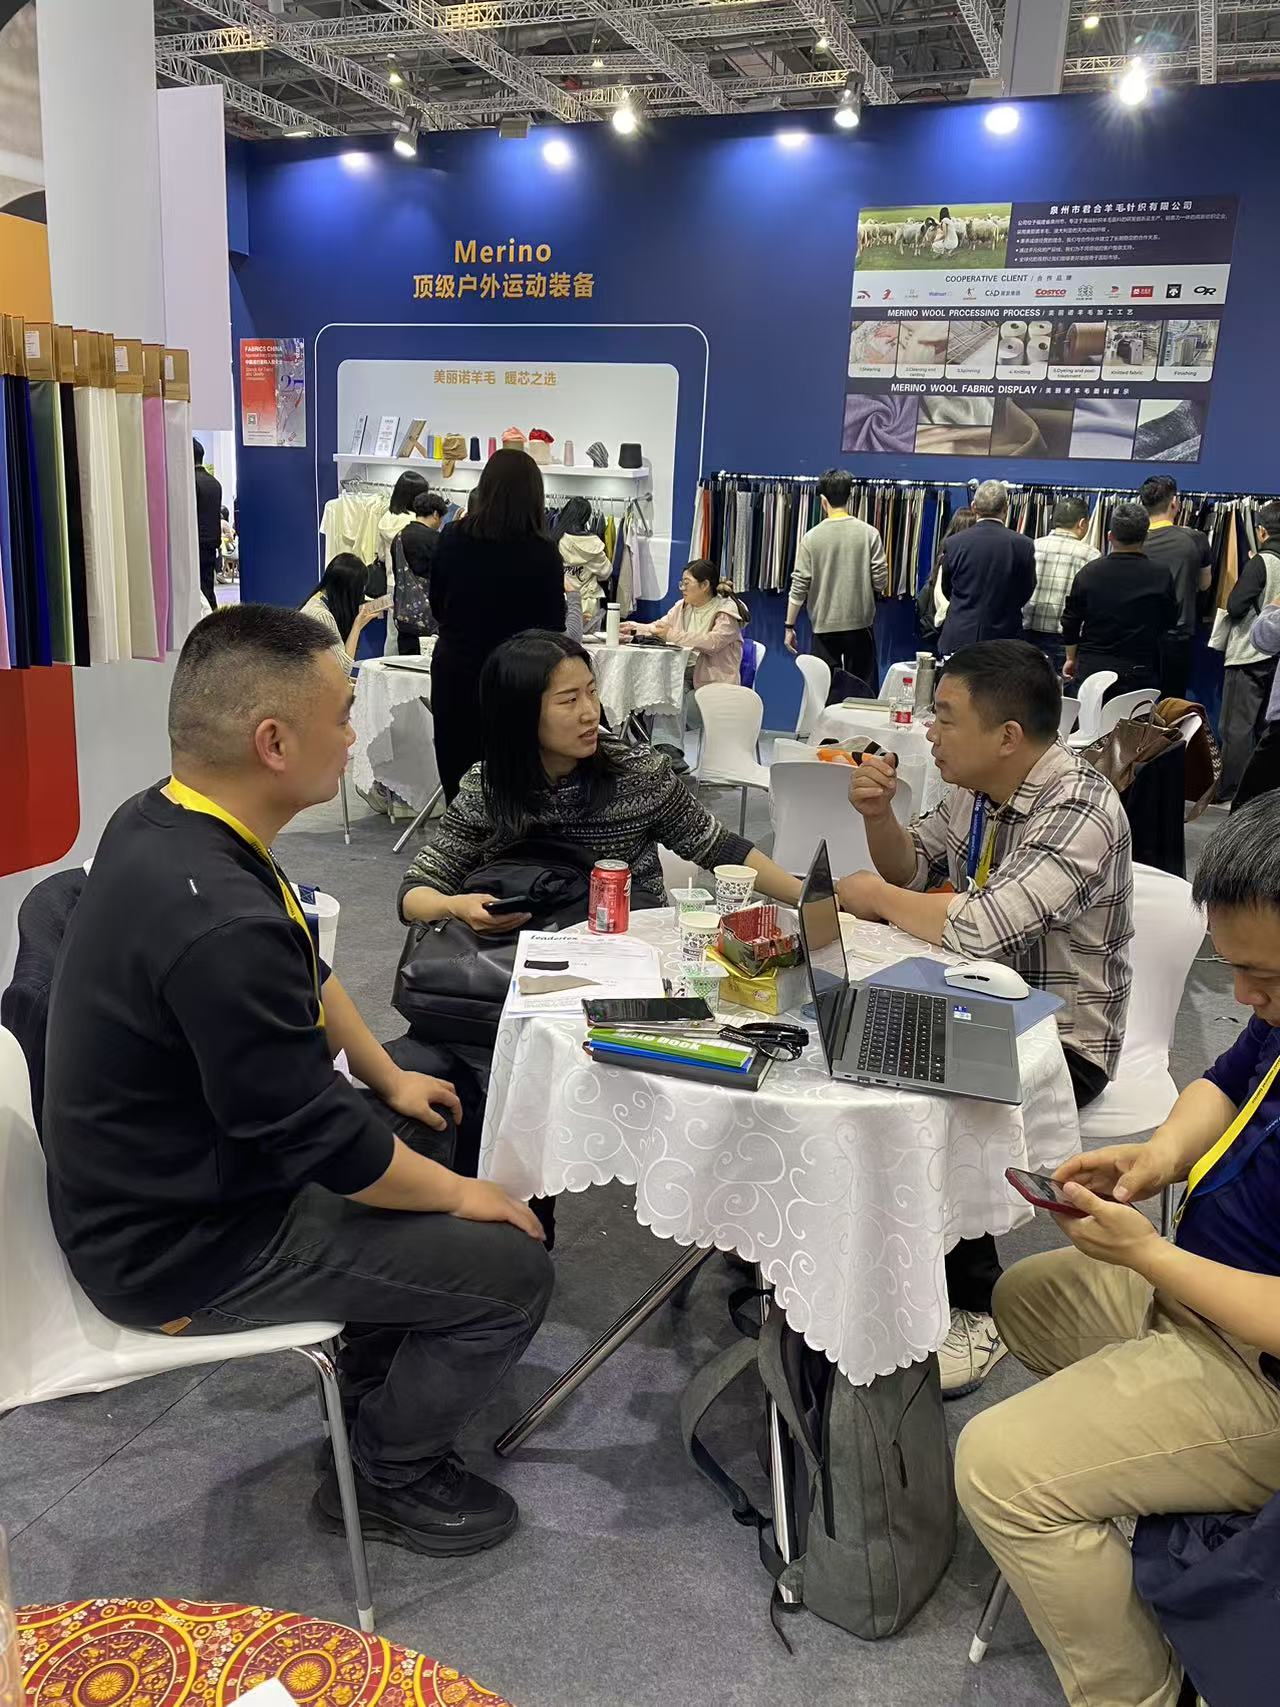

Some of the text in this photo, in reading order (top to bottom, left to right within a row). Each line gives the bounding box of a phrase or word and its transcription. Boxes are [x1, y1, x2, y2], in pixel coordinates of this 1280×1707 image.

[1050, 201, 1193, 215] 泉州市君合羊毛针织有限公司
[454, 238, 552, 263] Merino
[412, 272, 595, 299] 顶级户外运动装备
[945, 275, 998, 283] COOPERATIVE
[1001, 274, 1028, 282] CLIENT
[887, 309, 918, 317] MERINO
[921, 309, 946, 317] WOOL
[1003, 309, 1041, 317] PROCESS
[433, 369, 557, 386] 美丽诺羊毛 暖芯之选
[891, 383, 927, 393] MERINO
[930, 384, 958, 393] WOOL
[962, 384, 994, 394] FABRIC
[998, 385, 1038, 394] DISPLAY
